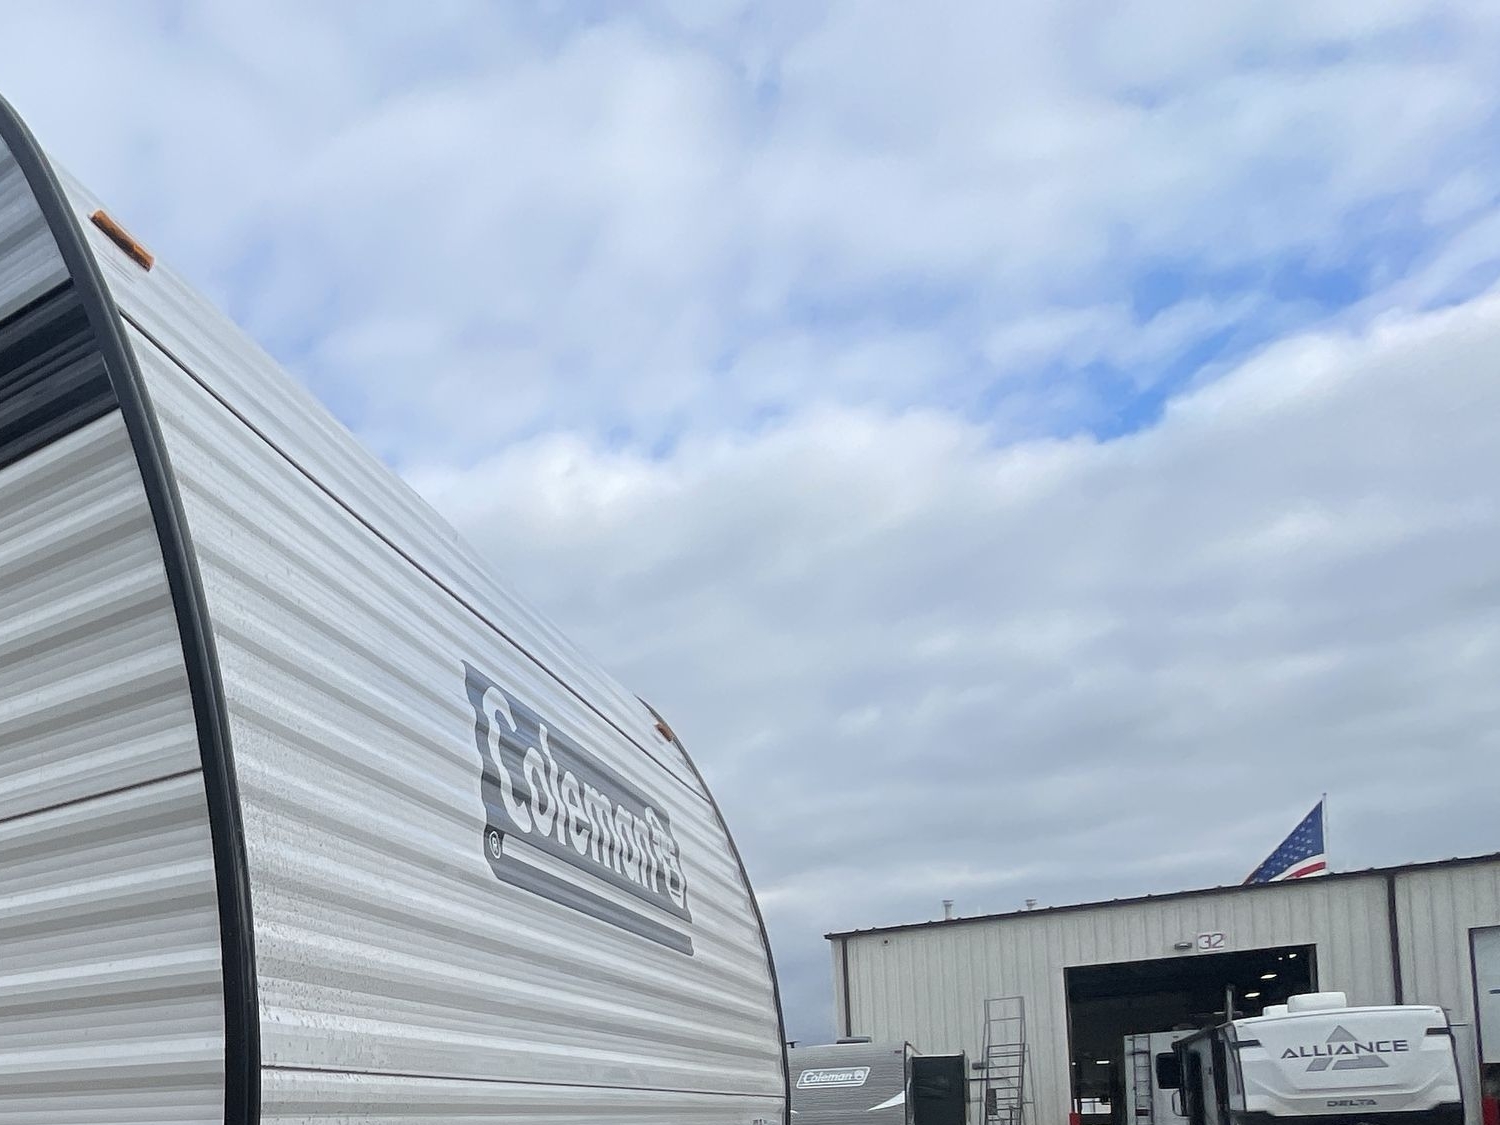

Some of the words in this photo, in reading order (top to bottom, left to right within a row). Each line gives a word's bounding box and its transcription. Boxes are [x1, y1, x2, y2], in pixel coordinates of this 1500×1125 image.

[482, 686, 660, 894] Coleman
[1198, 933, 1225, 949] 32
[1280, 1040, 1409, 1059] ALLIANCE
[803, 1071, 853, 1083] Coleman
[1326, 1099, 1378, 1107] DELTA
